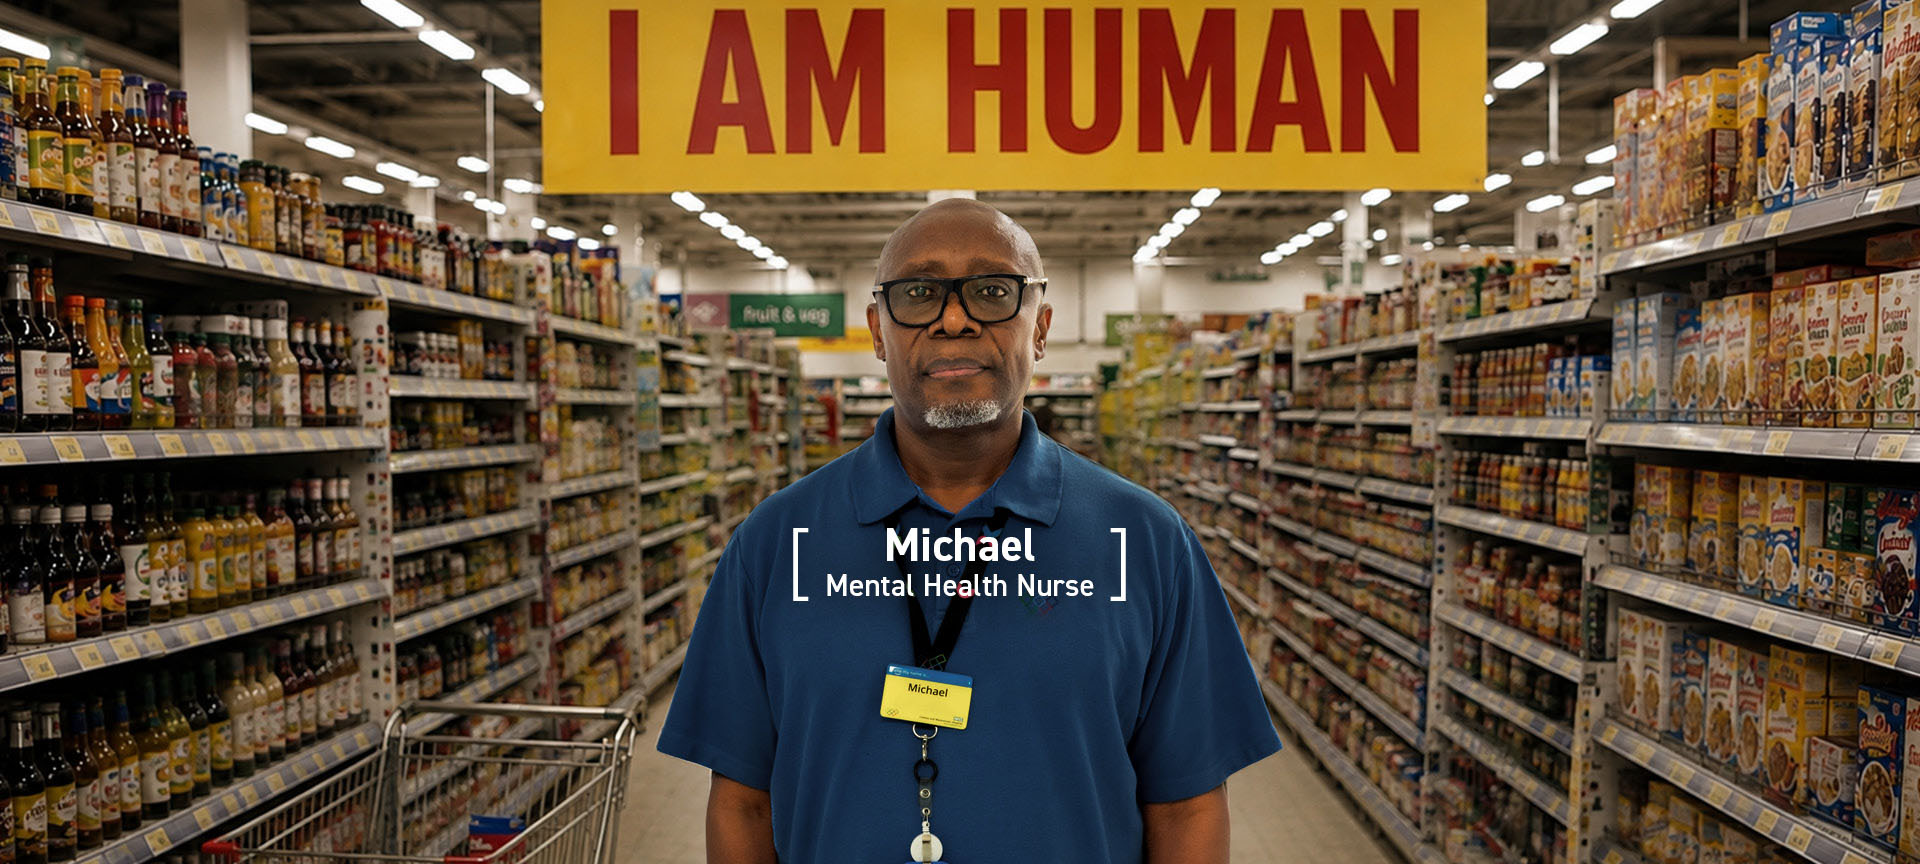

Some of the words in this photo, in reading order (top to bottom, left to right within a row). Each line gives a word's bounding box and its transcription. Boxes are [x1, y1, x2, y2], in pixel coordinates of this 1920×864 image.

[609, 8, 640, 156] I
[687, 8, 886, 155] AM
[947, 8, 1420, 155] HUMAN
[743, 305, 780, 323] fruit
[782, 305, 795, 323] &
[799, 308, 830, 328] veg
[908, 683, 948, 697] Michael
